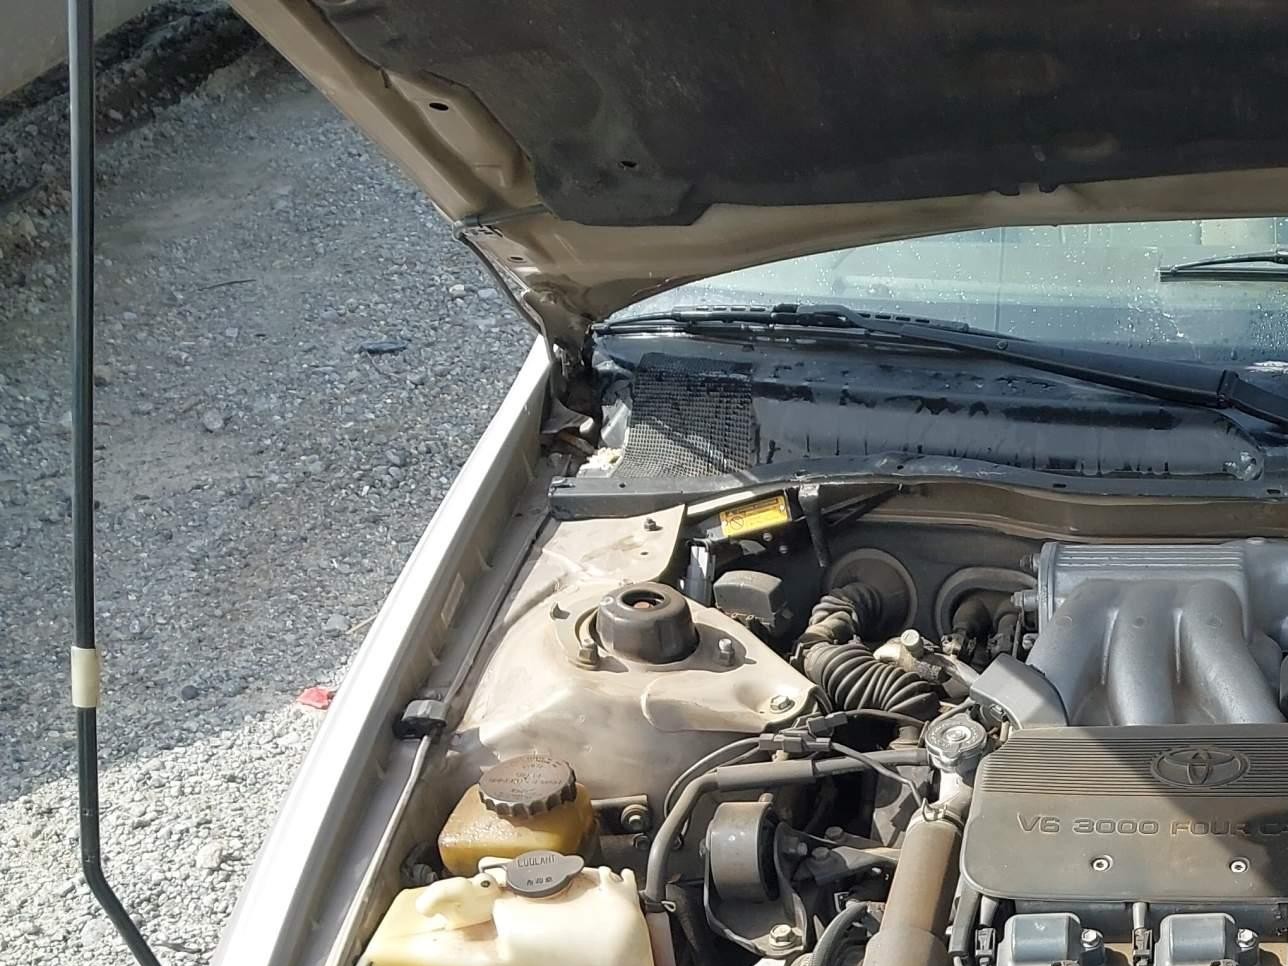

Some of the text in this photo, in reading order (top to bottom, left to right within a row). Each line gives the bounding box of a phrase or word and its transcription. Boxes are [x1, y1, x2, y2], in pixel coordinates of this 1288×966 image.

[1017, 813, 1060, 833] V6
[1072, 818, 1159, 835] 3000
[1171, 819, 1248, 835] FOUR
[517, 855, 556, 868] COOLANT
